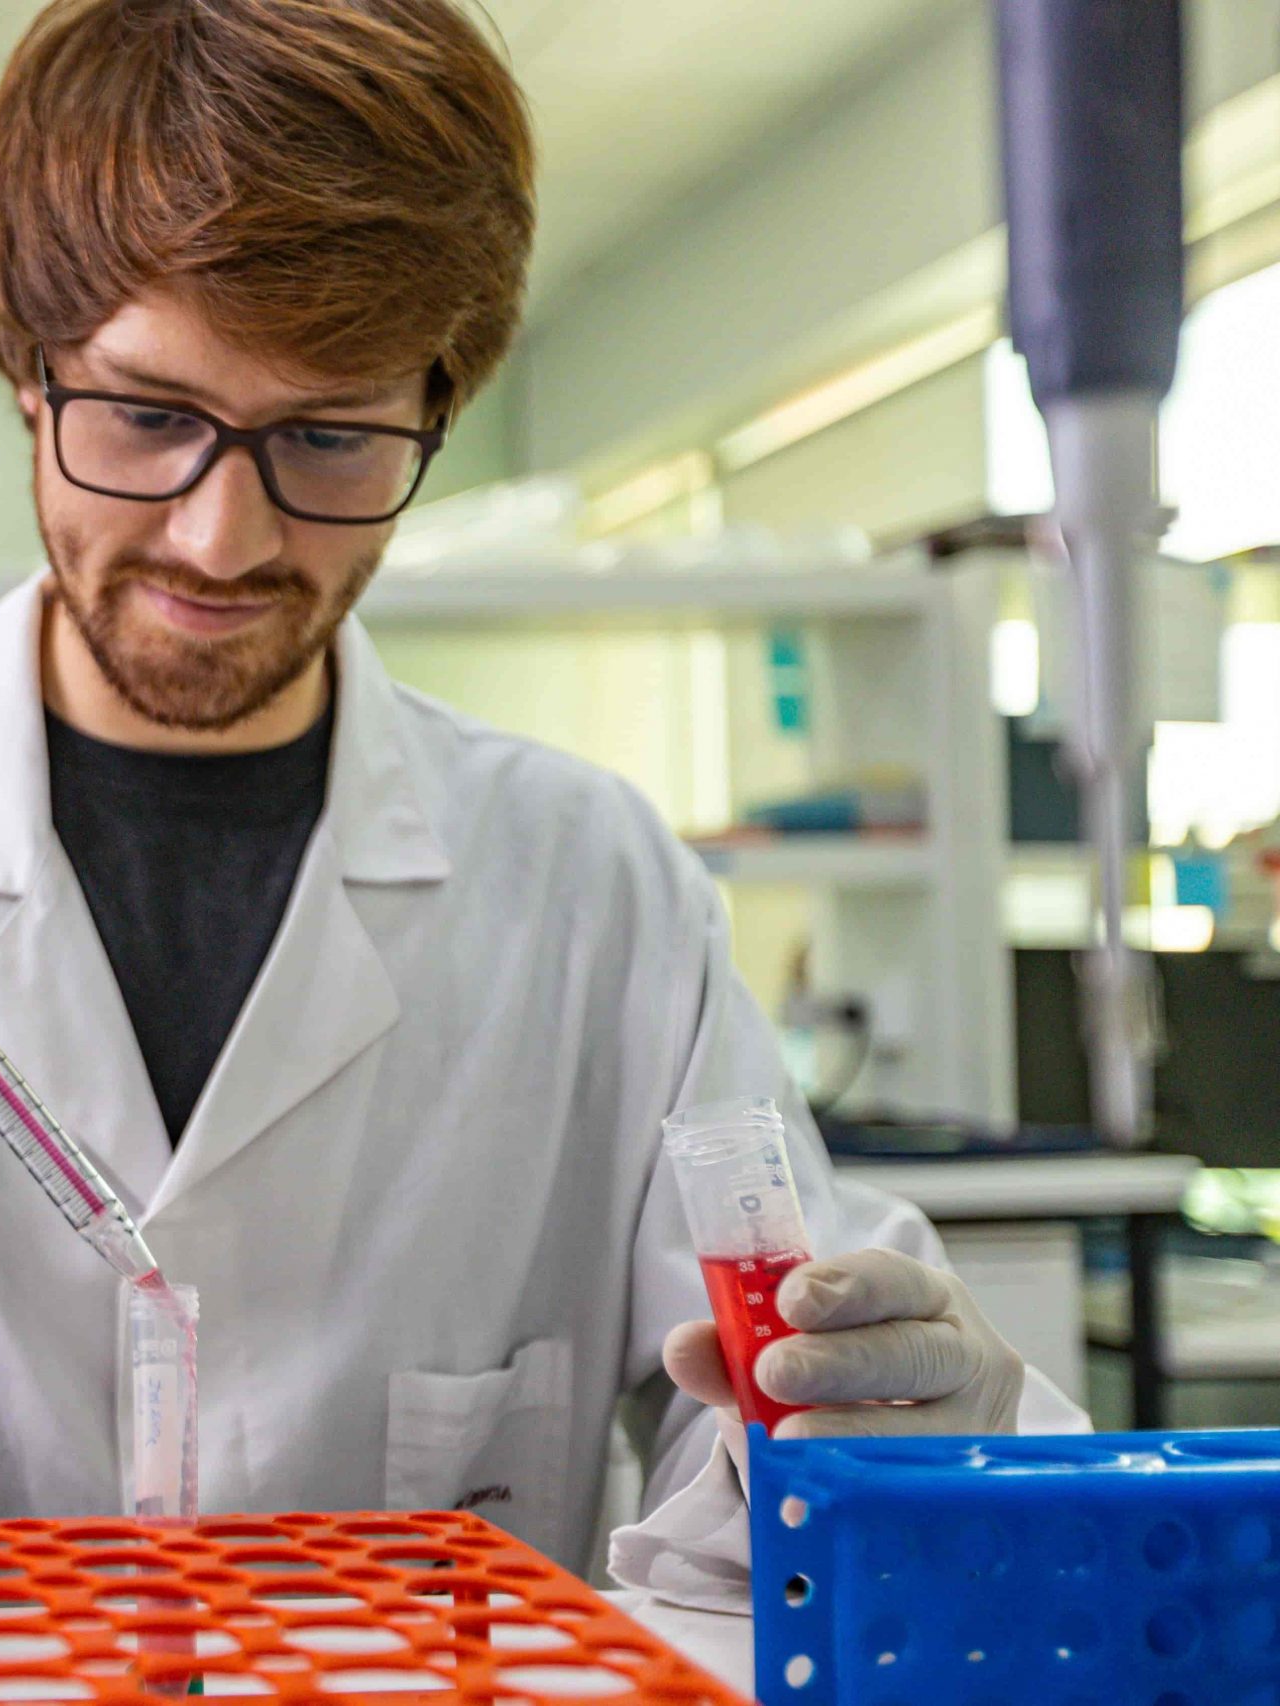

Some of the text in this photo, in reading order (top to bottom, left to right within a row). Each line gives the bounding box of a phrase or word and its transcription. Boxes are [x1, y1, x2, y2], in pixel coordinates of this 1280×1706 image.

[739, 1260, 756, 1273] 35
[746, 1291, 764, 1306] 30
[754, 1324, 773, 1338] 25
